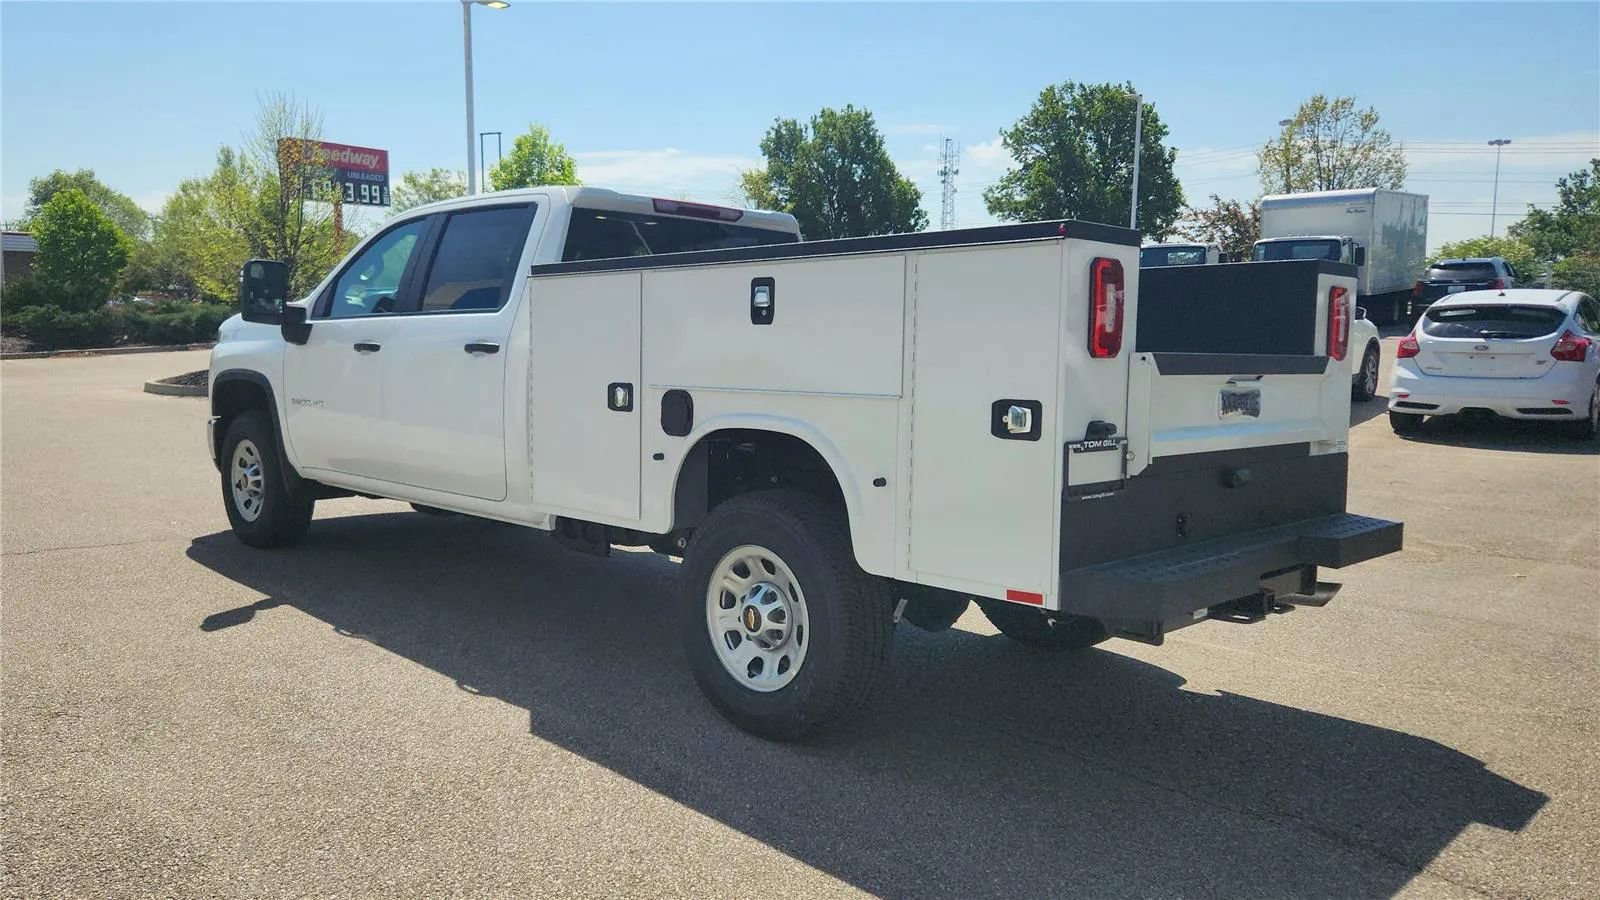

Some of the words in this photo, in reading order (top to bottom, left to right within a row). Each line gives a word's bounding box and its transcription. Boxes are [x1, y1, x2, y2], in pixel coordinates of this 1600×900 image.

[347, 172, 384, 182] UNLEADED
[1084, 440, 1102, 449] TOM
[1103, 439, 1117, 447] GILL
